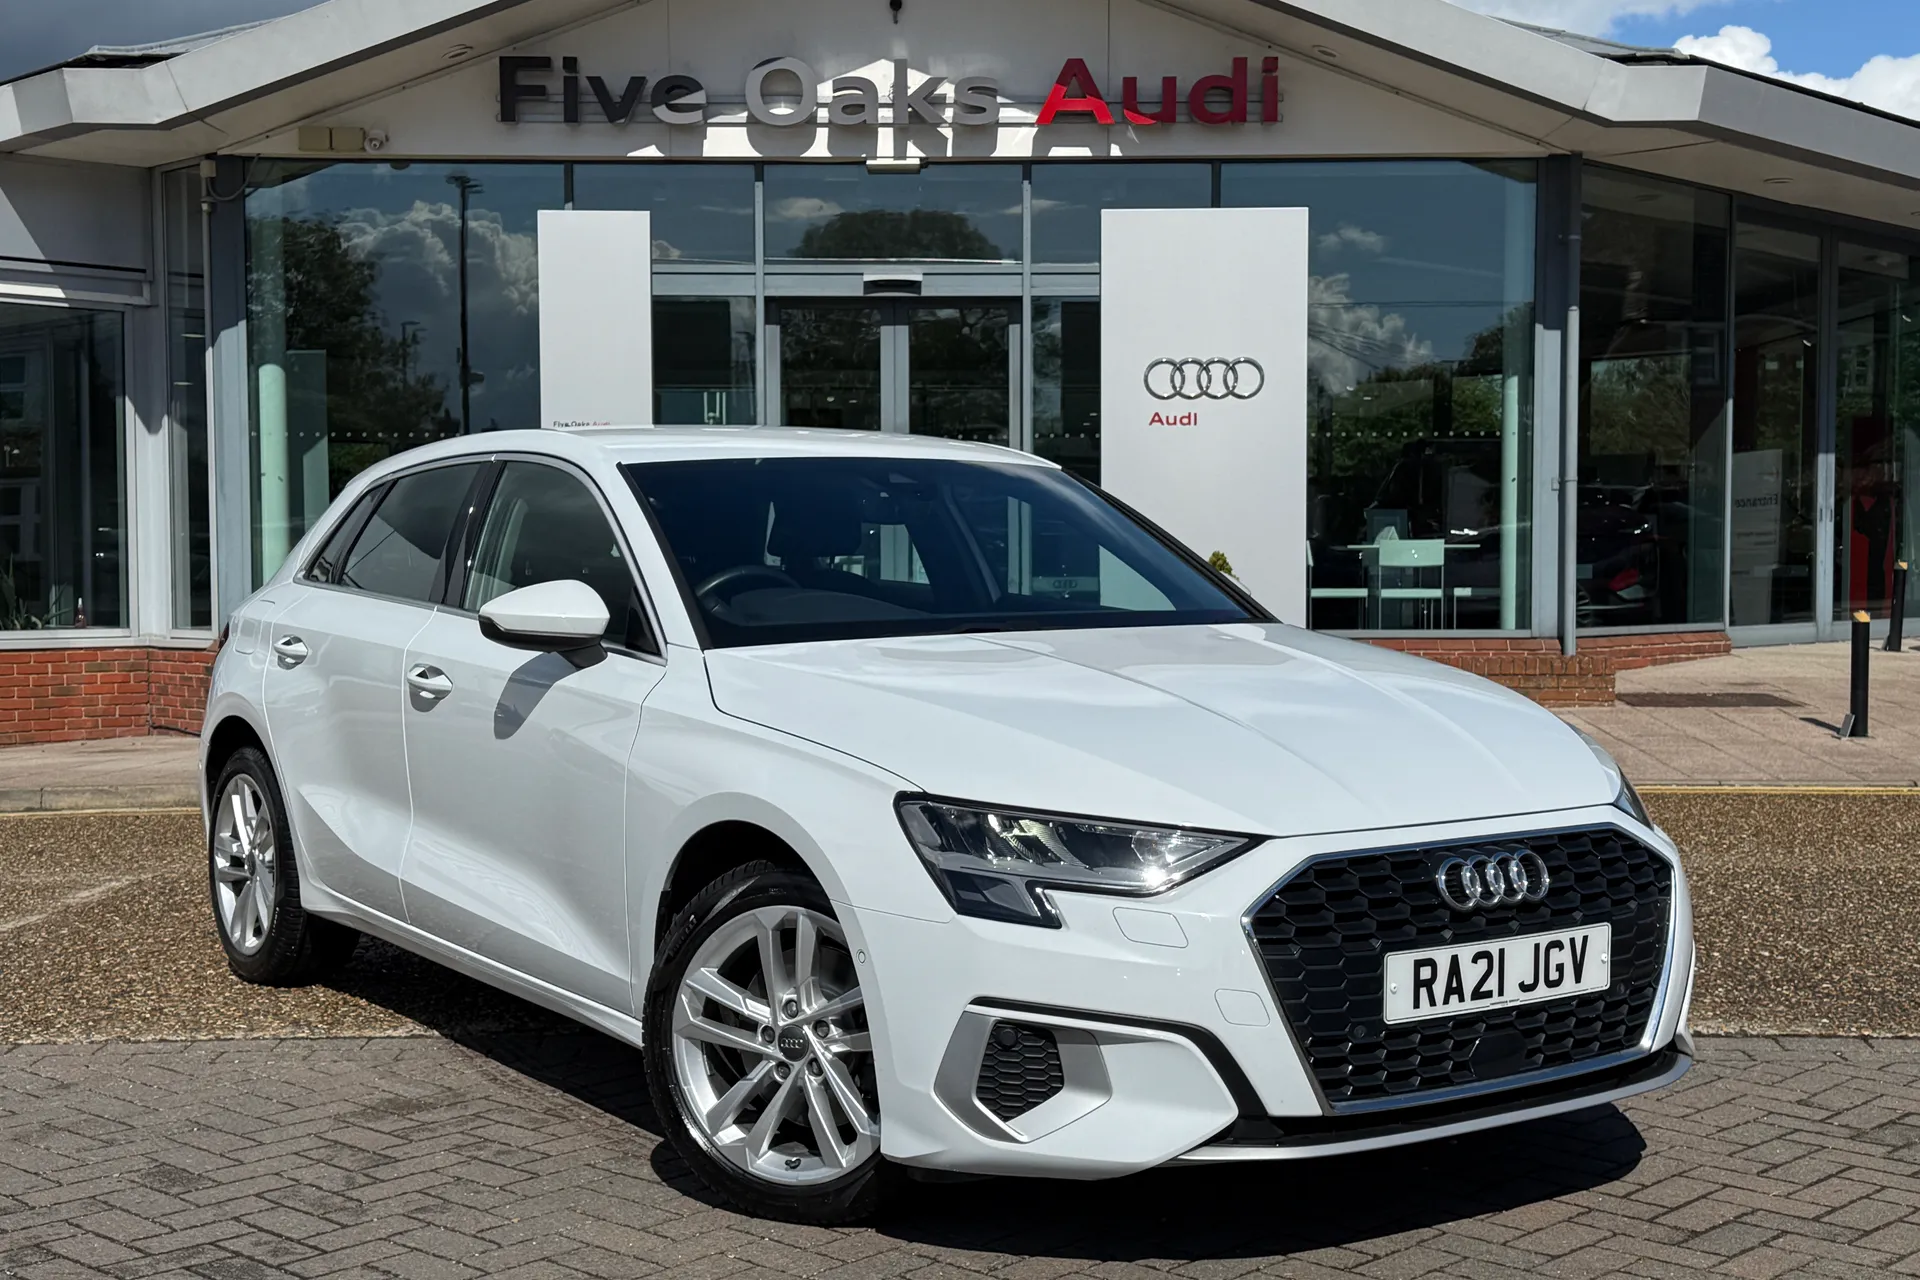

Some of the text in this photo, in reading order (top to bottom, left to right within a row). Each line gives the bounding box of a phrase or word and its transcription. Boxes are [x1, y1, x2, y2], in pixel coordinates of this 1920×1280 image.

[499, 56, 1280, 126] Five Oaks Audi
[1148, 411, 1198, 427] Audi
[1412, 934, 1589, 1010] RA21 JGV
